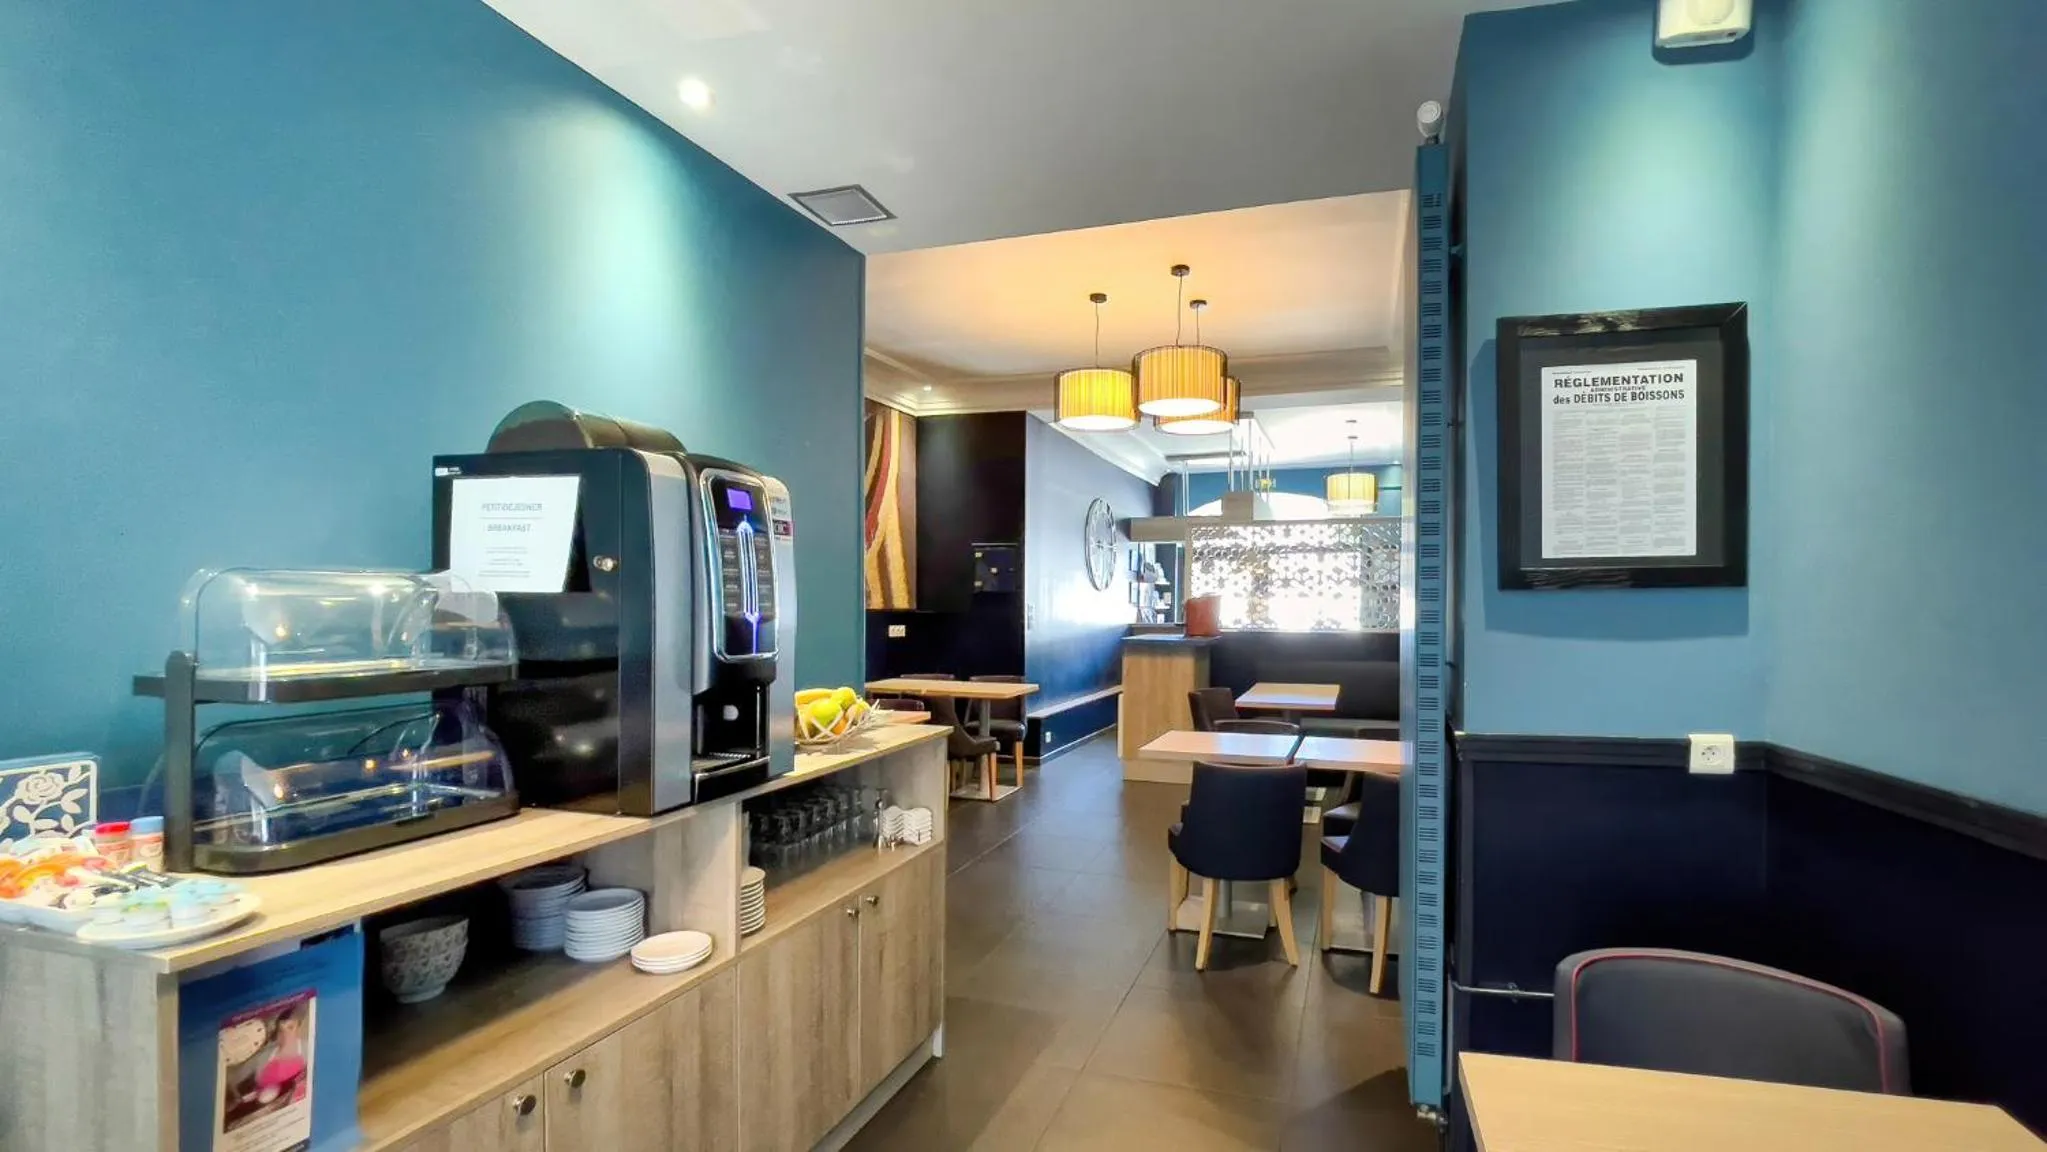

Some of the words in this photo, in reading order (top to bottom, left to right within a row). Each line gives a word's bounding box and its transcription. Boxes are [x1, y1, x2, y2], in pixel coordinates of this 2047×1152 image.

[1553, 373, 1684, 388] RÉGLEMENTATION
[1552, 395, 1571, 405] des
[1573, 391, 1611, 404] DÉBITS
[1613, 391, 1628, 402] DE
[1630, 389, 1685, 402] BOISSONS
